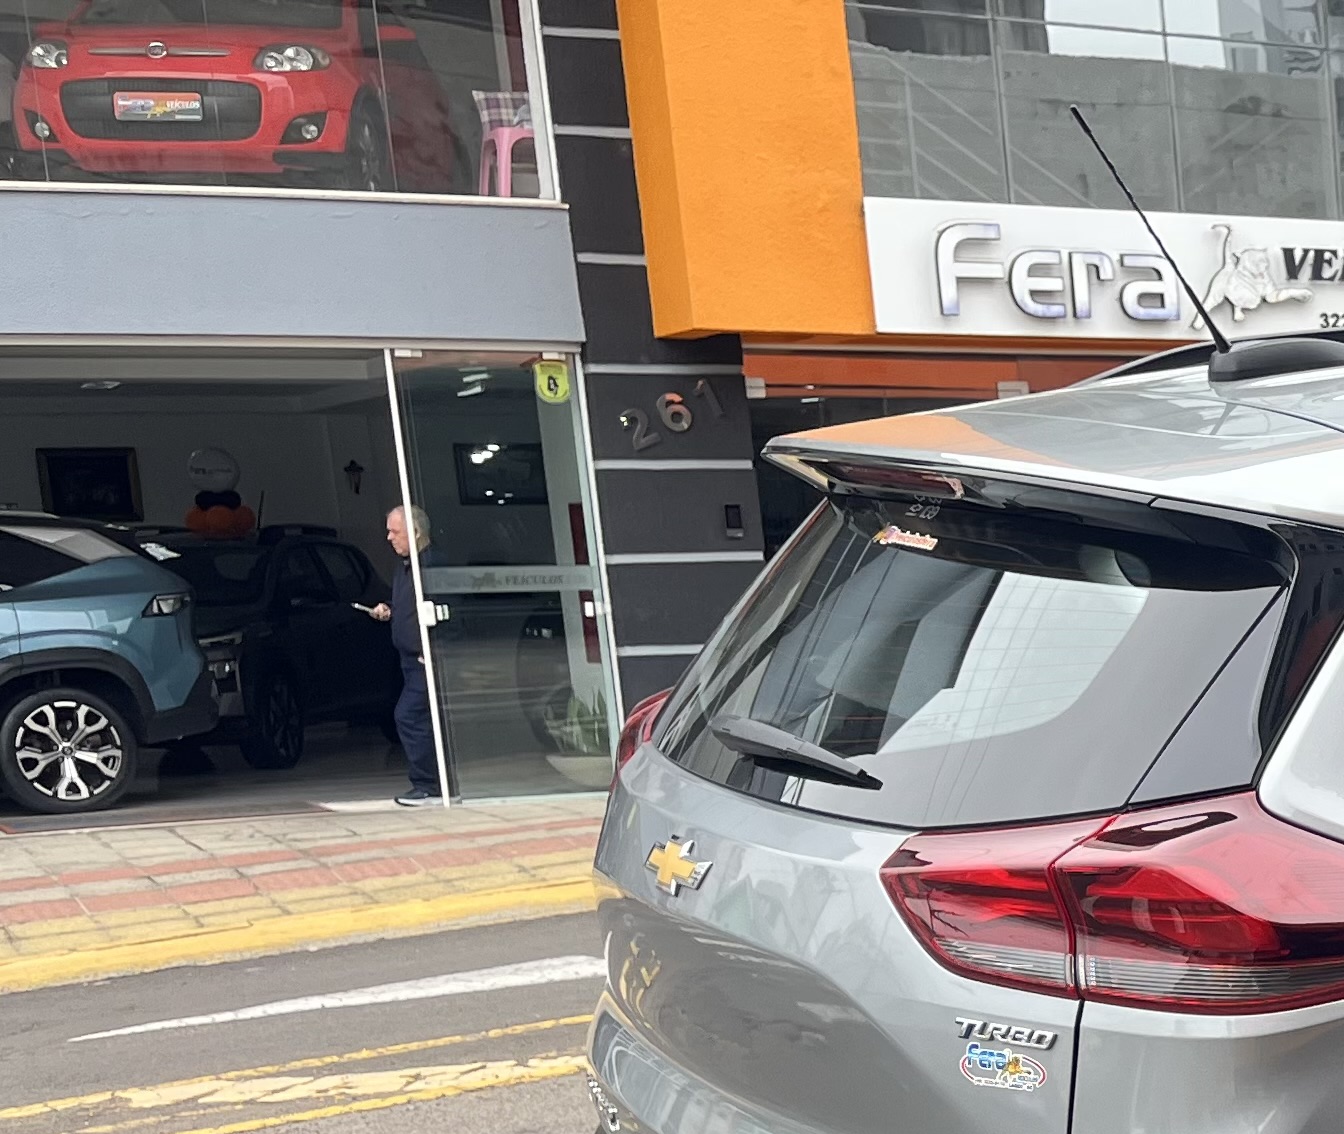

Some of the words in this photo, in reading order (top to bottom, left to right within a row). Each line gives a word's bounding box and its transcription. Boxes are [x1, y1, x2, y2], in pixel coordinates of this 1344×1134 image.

[935, 220, 1181, 322] Fera
[617, 379, 724, 451] 261
[955, 1016, 1059, 1050] TURBO
